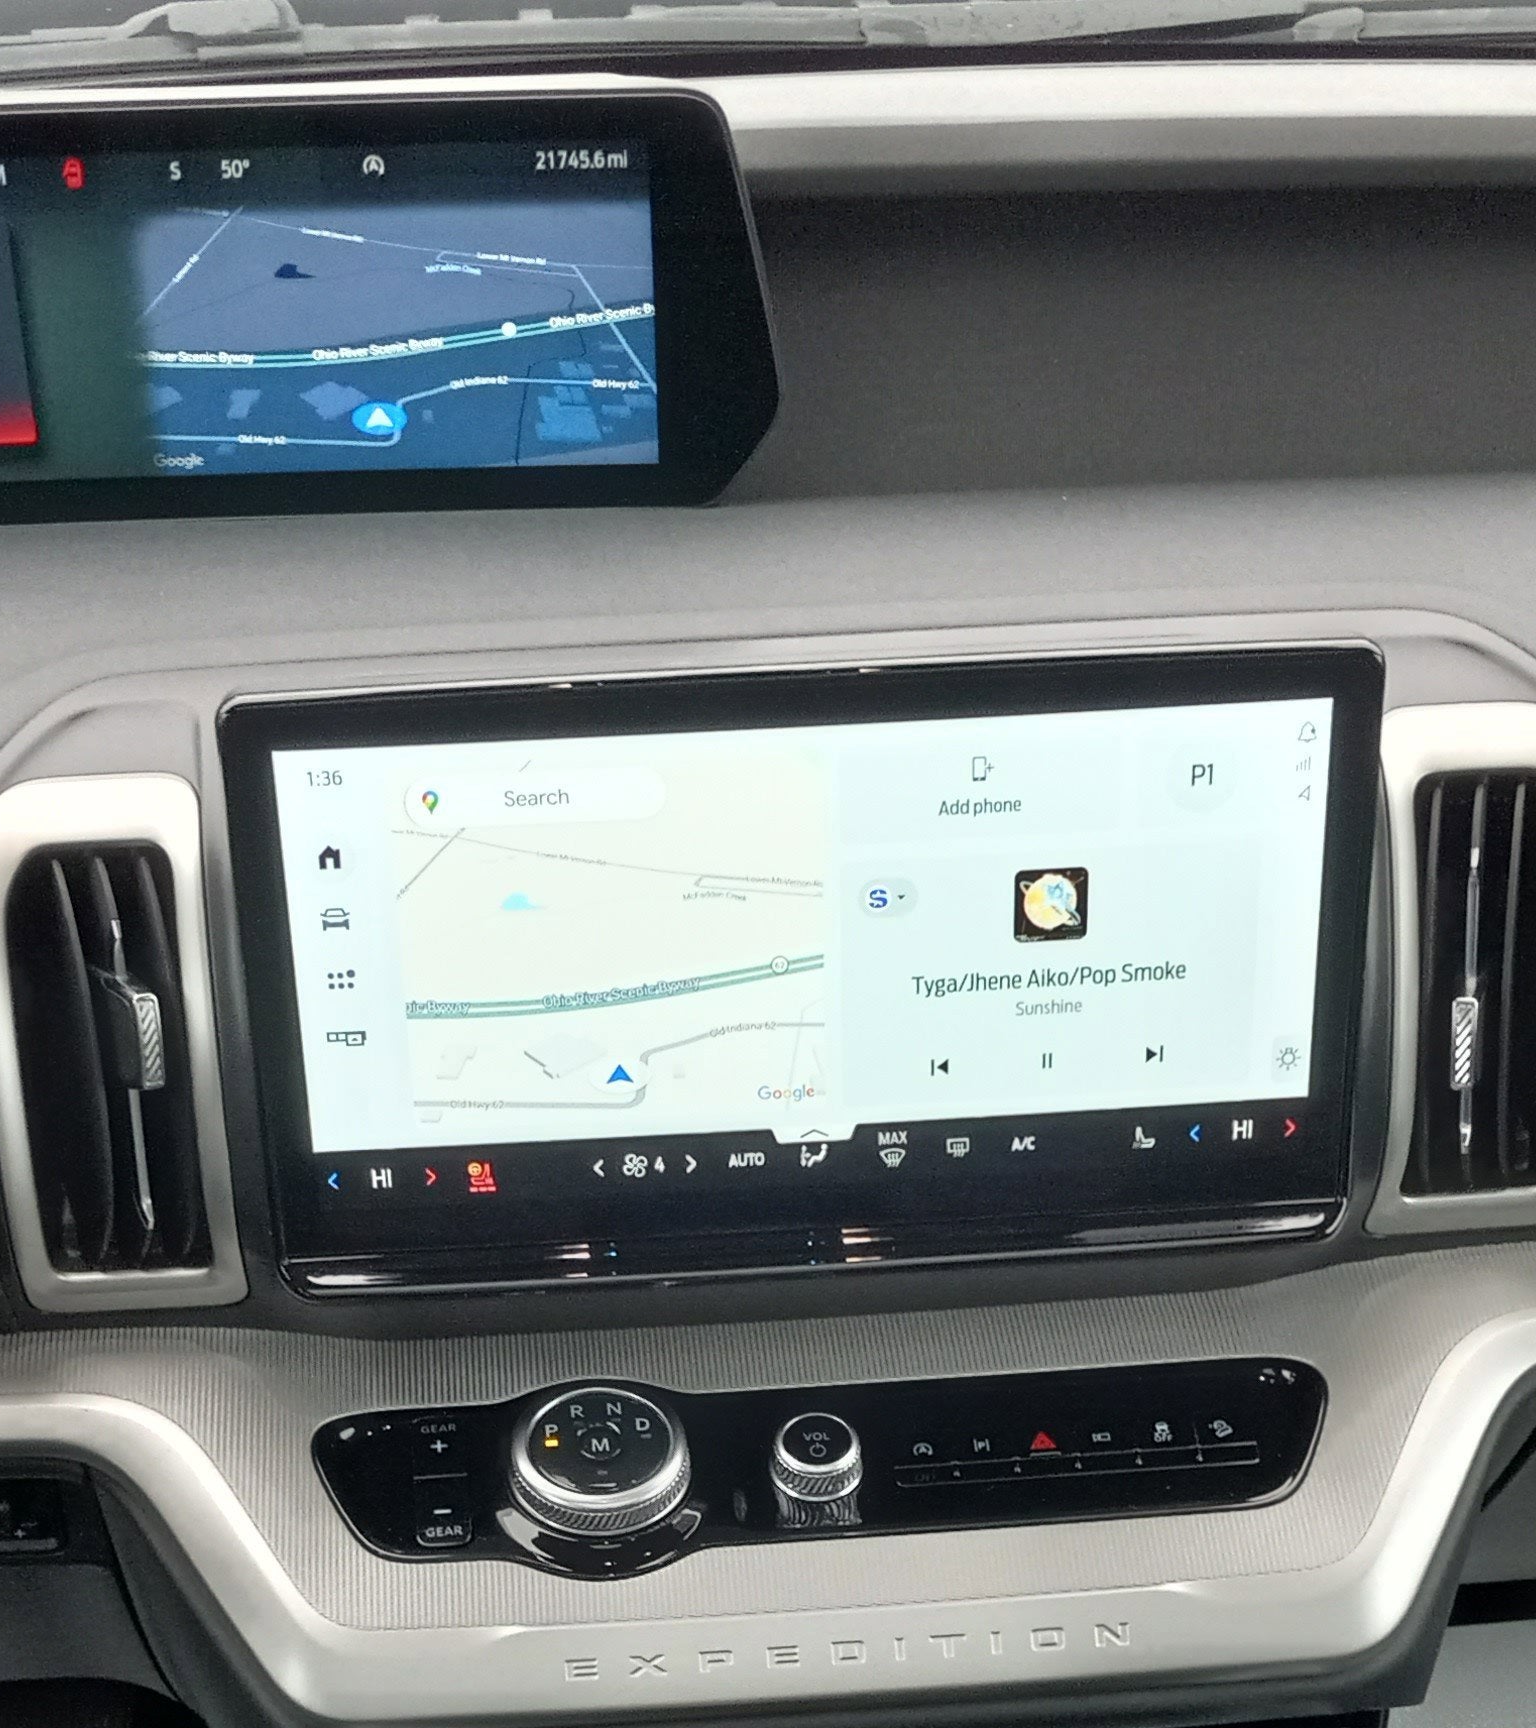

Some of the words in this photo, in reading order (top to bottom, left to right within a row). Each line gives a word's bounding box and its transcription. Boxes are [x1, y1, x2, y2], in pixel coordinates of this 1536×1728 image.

[535, 150, 605, 171] 21745.6
[169, 162, 182, 181] S
[548, 316, 575, 329] Ohio
[575, 312, 604, 324] River
[604, 308, 642, 321] Scenic
[311, 348, 339, 361] Ohio
[592, 378, 608, 388] Old
[608, 380, 627, 391] Hwy
[627, 380, 640, 390] 62
[154, 453, 205, 470] Google
[307, 769, 343, 787] 1:36
[1191, 764, 1215, 786] P1
[504, 788, 570, 807] Search
[938, 800, 971, 816] Add
[973, 798, 1022, 816] phone
[912, 972, 1022, 998] Tyga/Jhene
[1026, 965, 1116, 990] Aiko/Pop
[1121, 961, 1187, 983] Smoke
[541, 993, 574, 1008] Ohio
[575, 990, 610, 1005] River
[610, 983, 658, 1000] Scenic
[658, 977, 701, 995] Byway
[426, 999, 470, 1016] Byway
[1015, 999, 1083, 1017] Sunshine
[709, 1024, 726, 1037] Old
[726, 1020, 763, 1033] Indiana
[764, 1020, 778, 1030] 62
[757, 1084, 815, 1102] Google
[450, 1100, 468, 1109] Old
[1232, 1120, 1253, 1139] HI
[878, 1131, 907, 1146] MAX
[1011, 1135, 1036, 1152] A/C
[654, 1157, 664, 1172] 4
[728, 1153, 765, 1169] AUTO
[370, 1168, 392, 1188] HI
[570, 1405, 584, 1419] R
[606, 1402, 622, 1416] N
[420, 1424, 457, 1435] GEAR
[545, 1425, 558, 1438] P
[635, 1418, 650, 1432] D
[802, 1432, 830, 1442] VOL
[591, 1439, 610, 1453] M
[425, 1525, 464, 1537] GEAR
[564, 1622, 1131, 1682] EXPEDITION
